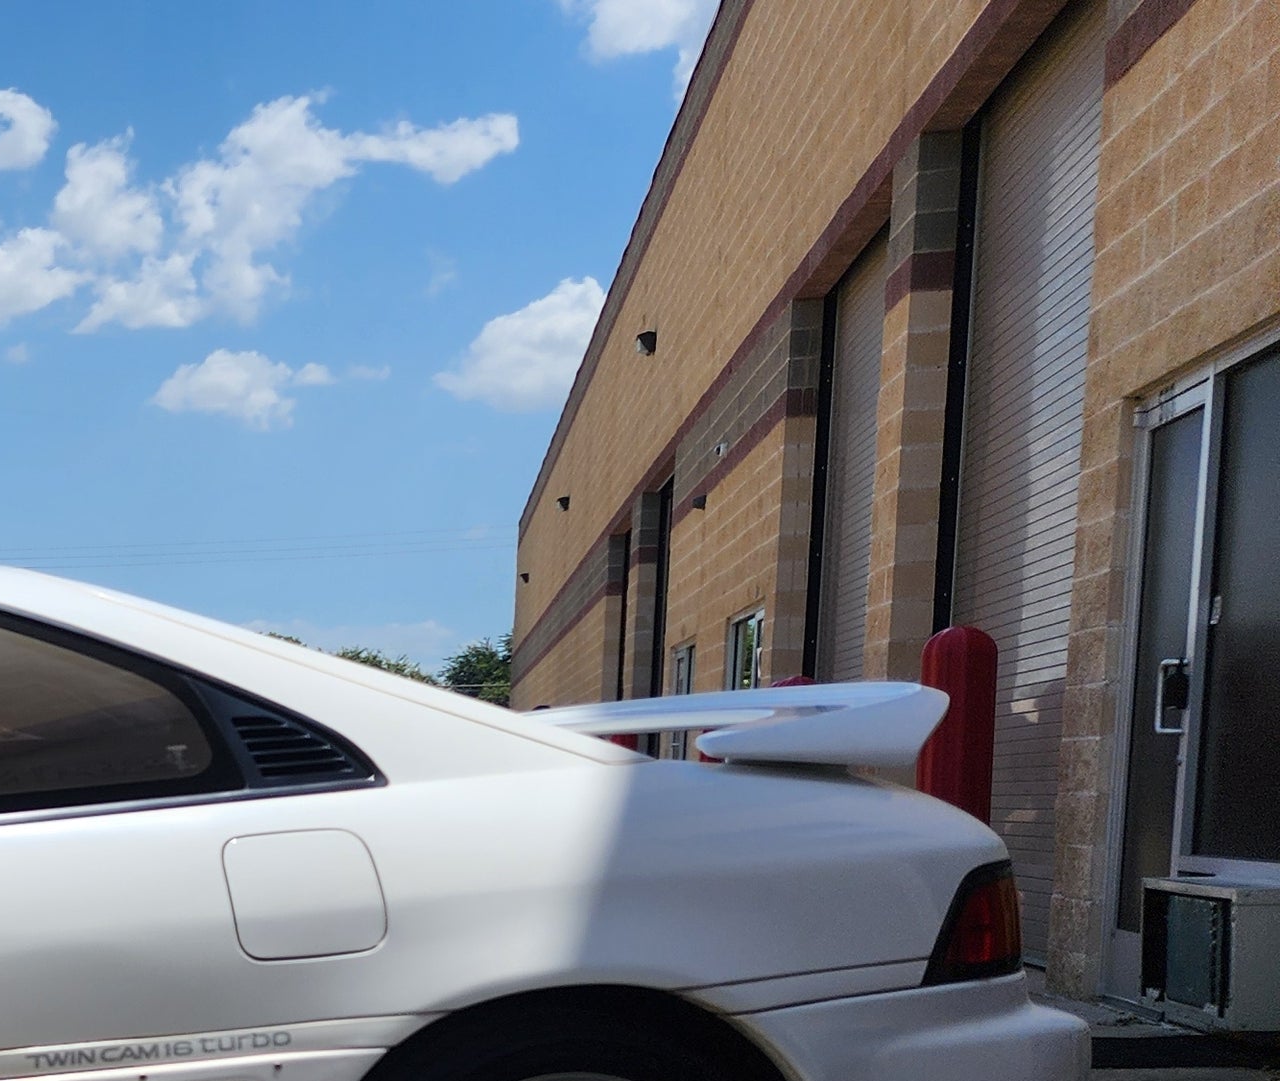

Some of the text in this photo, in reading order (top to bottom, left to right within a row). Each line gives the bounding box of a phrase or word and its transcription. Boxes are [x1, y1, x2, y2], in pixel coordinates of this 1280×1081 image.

[25, 1031, 292, 1069] TWIN CAM 16 turbo
